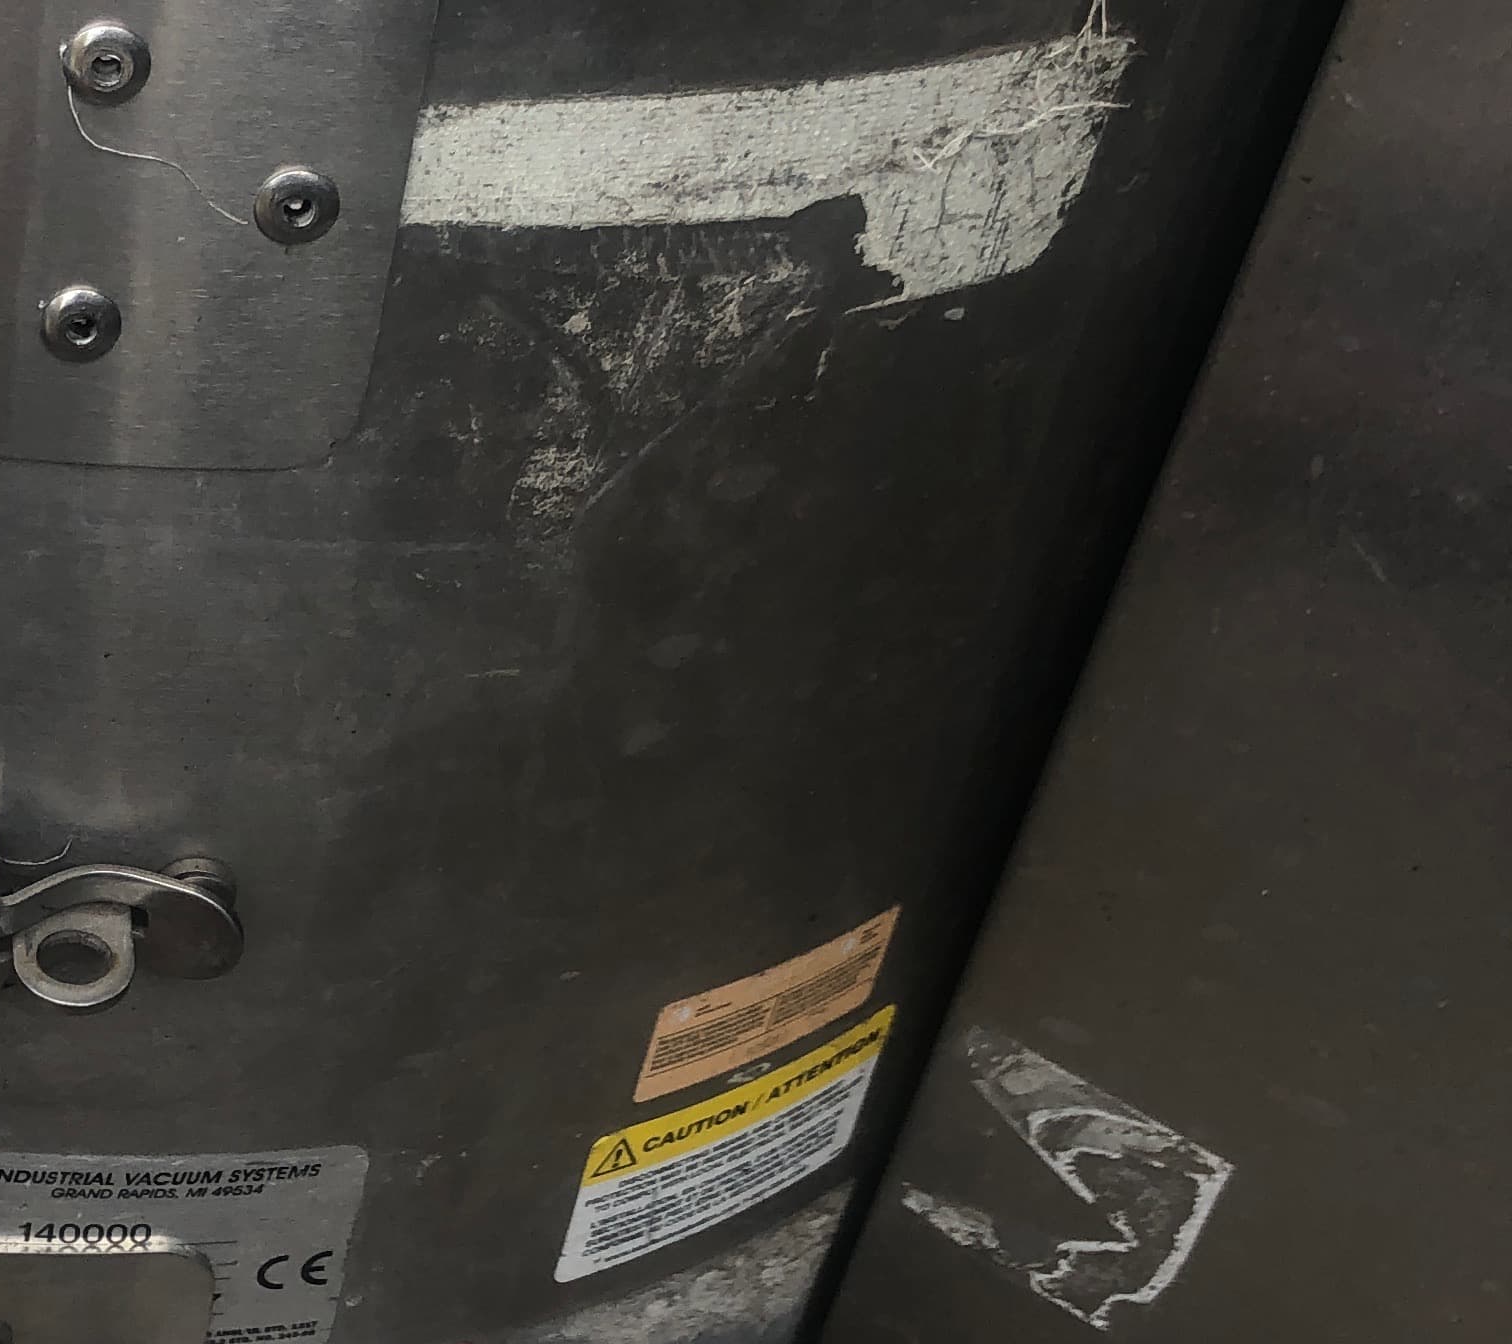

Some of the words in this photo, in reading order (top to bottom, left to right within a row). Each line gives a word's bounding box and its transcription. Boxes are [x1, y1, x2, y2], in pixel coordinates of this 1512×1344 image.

[642, 1100, 749, 1153] CAUTION
[764, 1030, 881, 1103] ATTENTION
[125, 1170, 223, 1186] VACUUM
[228, 1163, 322, 1183] SYSTEMS
[51, 1187, 113, 1200] GRAND
[185, 1186, 208, 1199] MI
[18, 1222, 152, 1244] 140000
